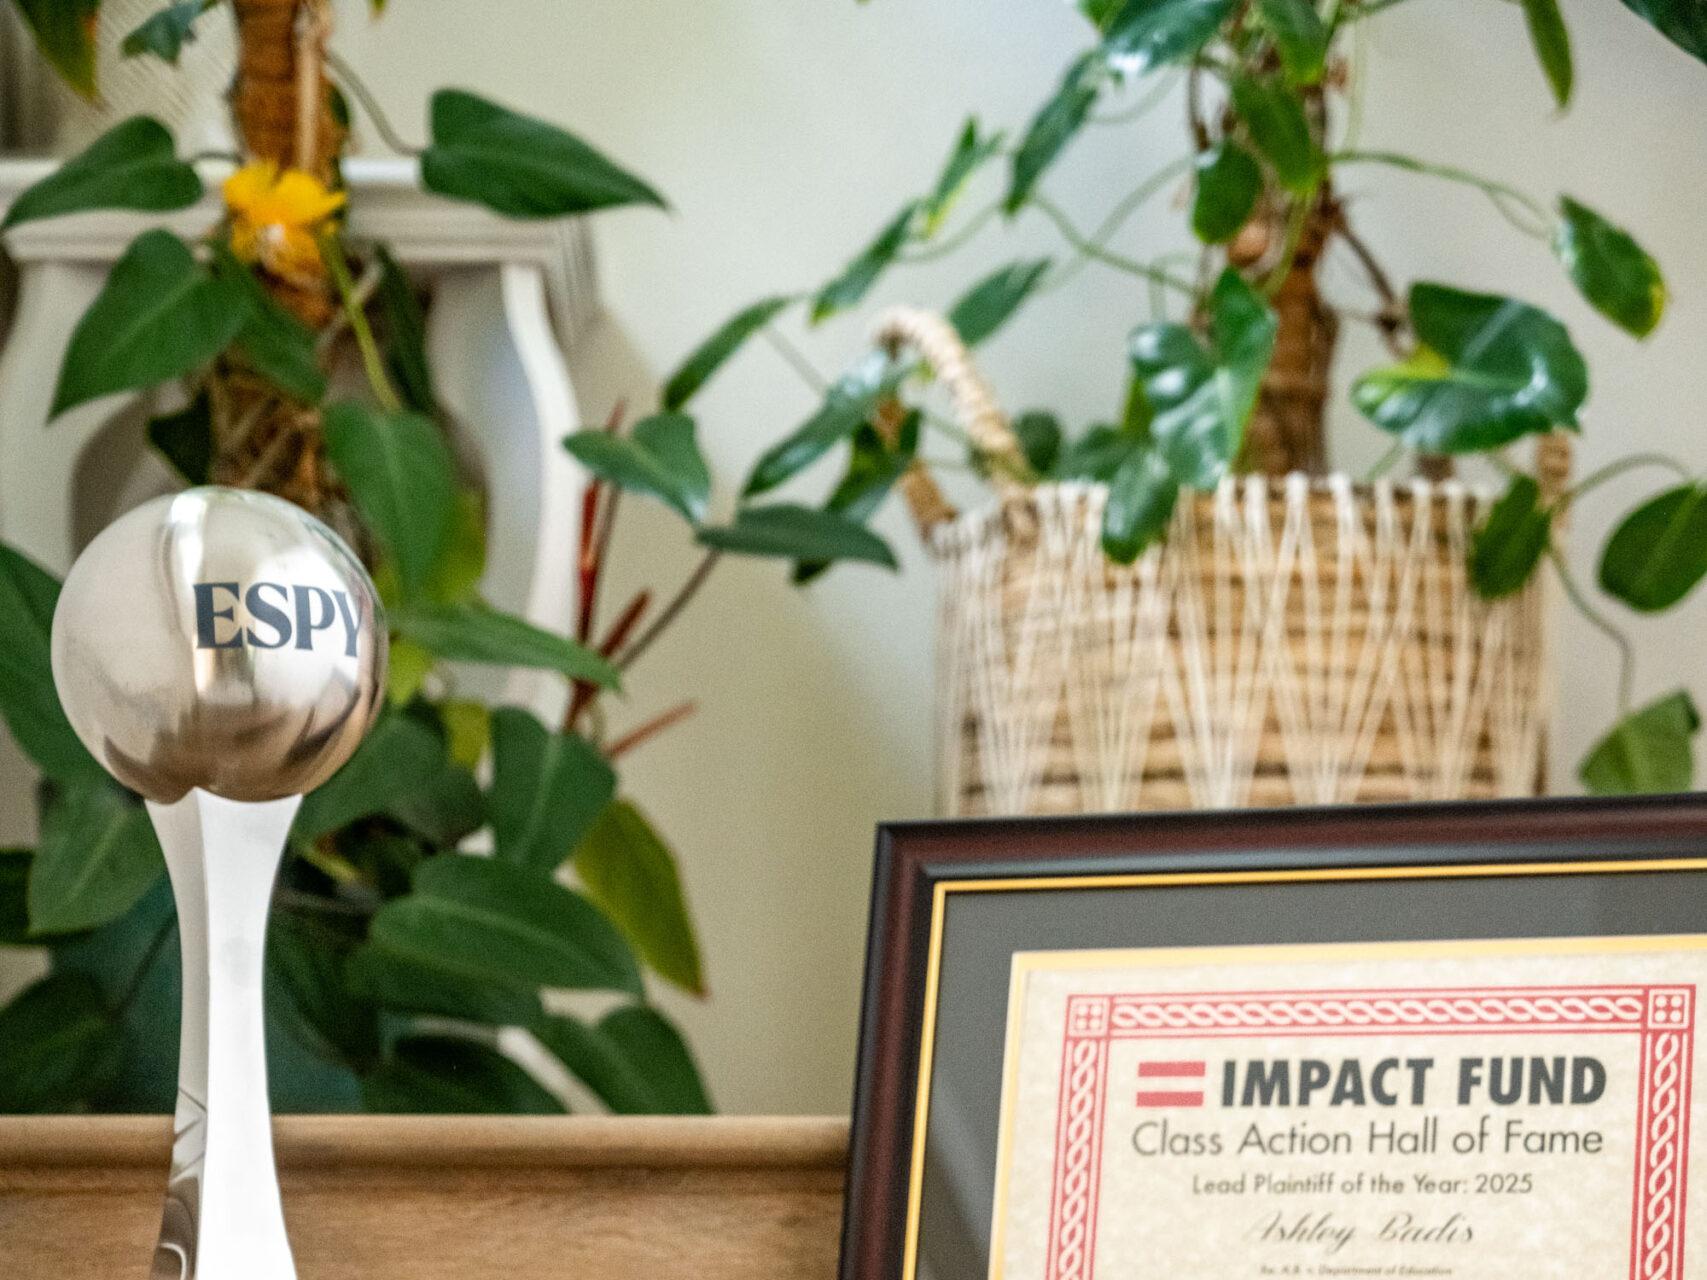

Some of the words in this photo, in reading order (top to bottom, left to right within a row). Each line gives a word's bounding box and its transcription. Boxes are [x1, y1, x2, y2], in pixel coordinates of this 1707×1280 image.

[1221, 1058, 1435, 1107] IMPACT
[1459, 1057, 1607, 1105] FUND
[1132, 1121, 1223, 1156] Class
[1238, 1123, 1352, 1155] Action
[1368, 1118, 1437, 1154] Hall
[1452, 1116, 1491, 1154] of
[1504, 1119, 1603, 1154] Fame
[1193, 1174, 1245, 1195] Lead
[1254, 1174, 1335, 1195] Plaintiff
[1342, 1174, 1365, 1195] of
[1370, 1174, 1405, 1194] the
[1414, 1175, 1467, 1195] Year:
[1476, 1174, 1533, 1194] 2025
